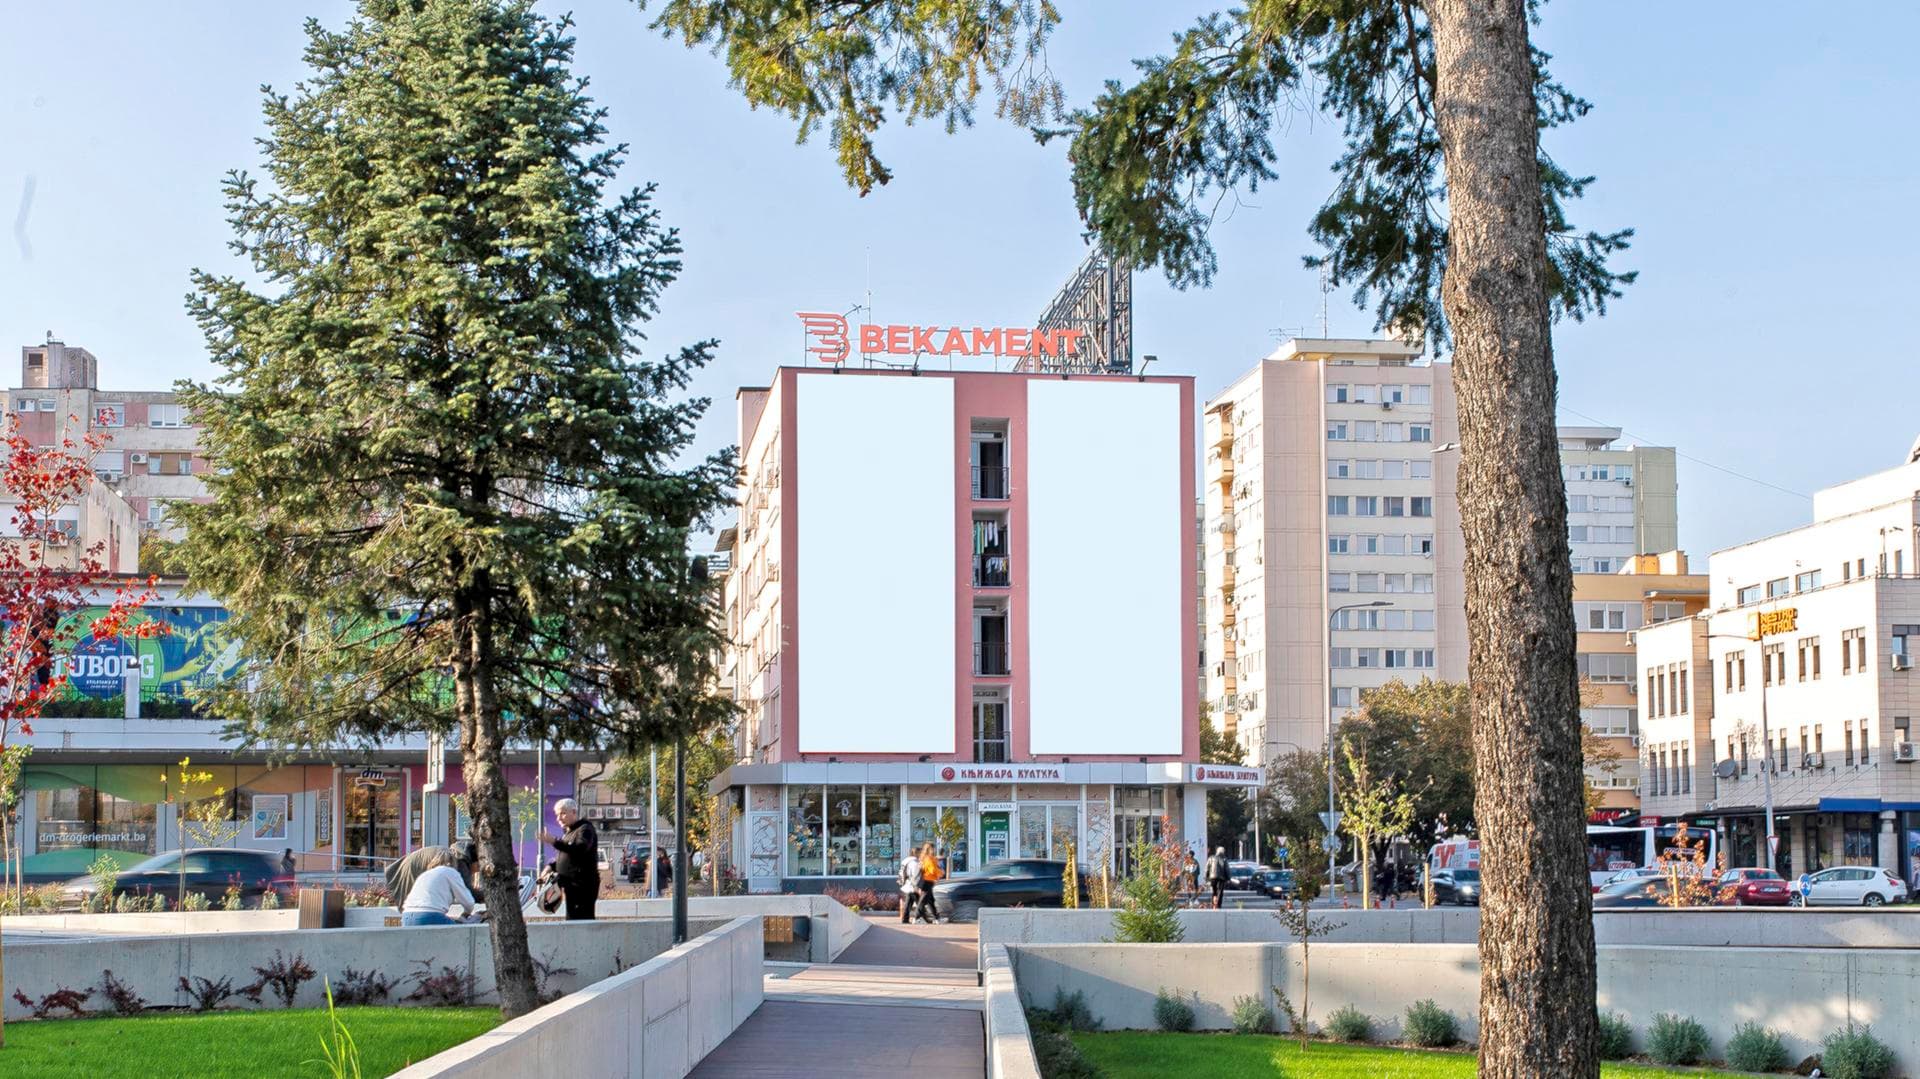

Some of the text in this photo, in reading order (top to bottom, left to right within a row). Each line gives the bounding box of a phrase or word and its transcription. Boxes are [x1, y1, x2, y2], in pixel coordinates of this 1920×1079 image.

[860, 324, 1083, 357] BEKAMENT
[361, 768, 383, 779] dm
[40, 832, 146, 844] dm-drogeriemarkt.ba
